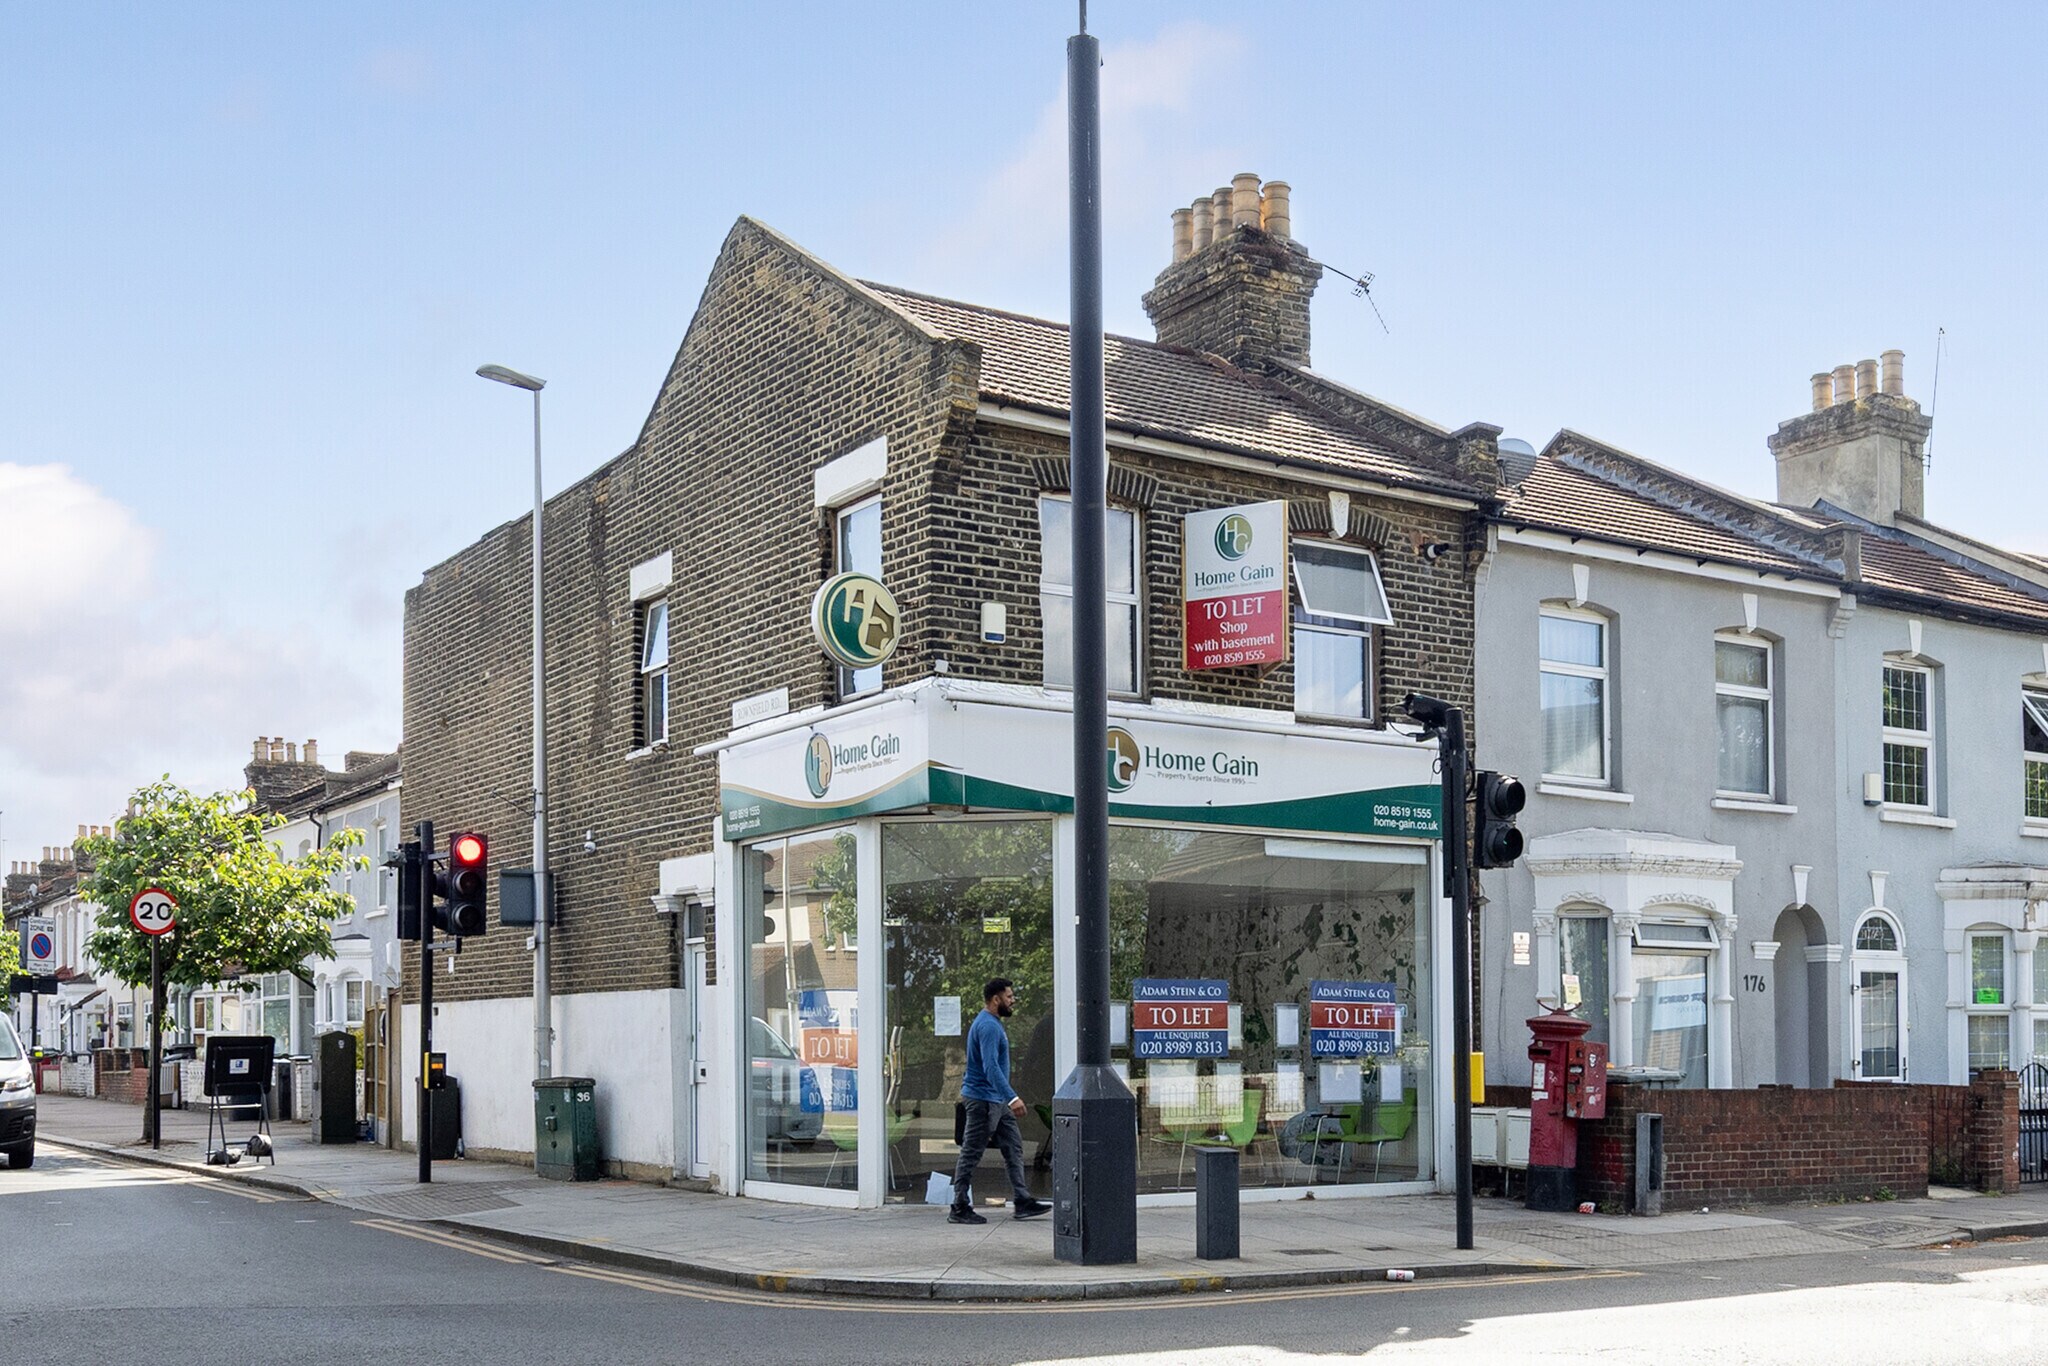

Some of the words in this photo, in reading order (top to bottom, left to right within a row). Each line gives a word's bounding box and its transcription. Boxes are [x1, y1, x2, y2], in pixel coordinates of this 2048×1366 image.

[1195, 571, 1236, 587] Home
[1240, 564, 1274, 581] Gain
[1203, 600, 1227, 620] TO
[1232, 596, 1265, 617] LET
[1220, 621, 1248, 635] Shop
[1194, 639, 1219, 652] with
[1221, 633, 1275, 650] basement
[1204, 654, 1222, 665] 020
[1223, 651, 1244, 664] 8519
[1245, 649, 1266, 661] 1555
[833, 743, 868, 767] Home
[871, 733, 900, 758] Gain
[1144, 745, 1206, 772] Home
[1213, 751, 1259, 777] Gain
[1157, 771, 1186, 780] Property
[1373, 804, 1390, 816] 020
[1390, 806, 1411, 817] 8519
[1412, 807, 1432, 819] 1555
[1373, 816, 1439, 831] home-gain.co.uk
[139, 901, 172, 921] 20
[1141, 986, 1168, 996] ADAM
[1170, 985, 1196, 996] STEIN
[1198, 986, 1206, 996] &
[1743, 974, 1766, 992] 176
[1317, 987, 1342, 997] ADAM
[1343, 987, 1367, 998] STEIN
[1368, 988, 1376, 998] &
[1149, 1007, 1177, 1025] TO
[1182, 1007, 1214, 1025] LET
[1324, 1007, 1350, 1025] TO
[1354, 1008, 1382, 1025] LET
[1153, 1031, 1167, 1039] ALL
[1168, 1031, 1210, 1041] ENQUIRIES
[1328, 1030, 1340, 1038] ALL
[1341, 1031, 1379, 1040] ENQUIRIES
[810, 1036, 831, 1058] TO
[833, 1037, 852, 1059] LET
[1140, 1041, 1162, 1055] 020
[1165, 1041, 1192, 1054] 8989
[1195, 1040, 1223, 1054] 8313
[1316, 1039, 1336, 1052] 020
[1338, 1040, 1363, 1053] 8989
[1365, 1040, 1390, 1053] 8313
